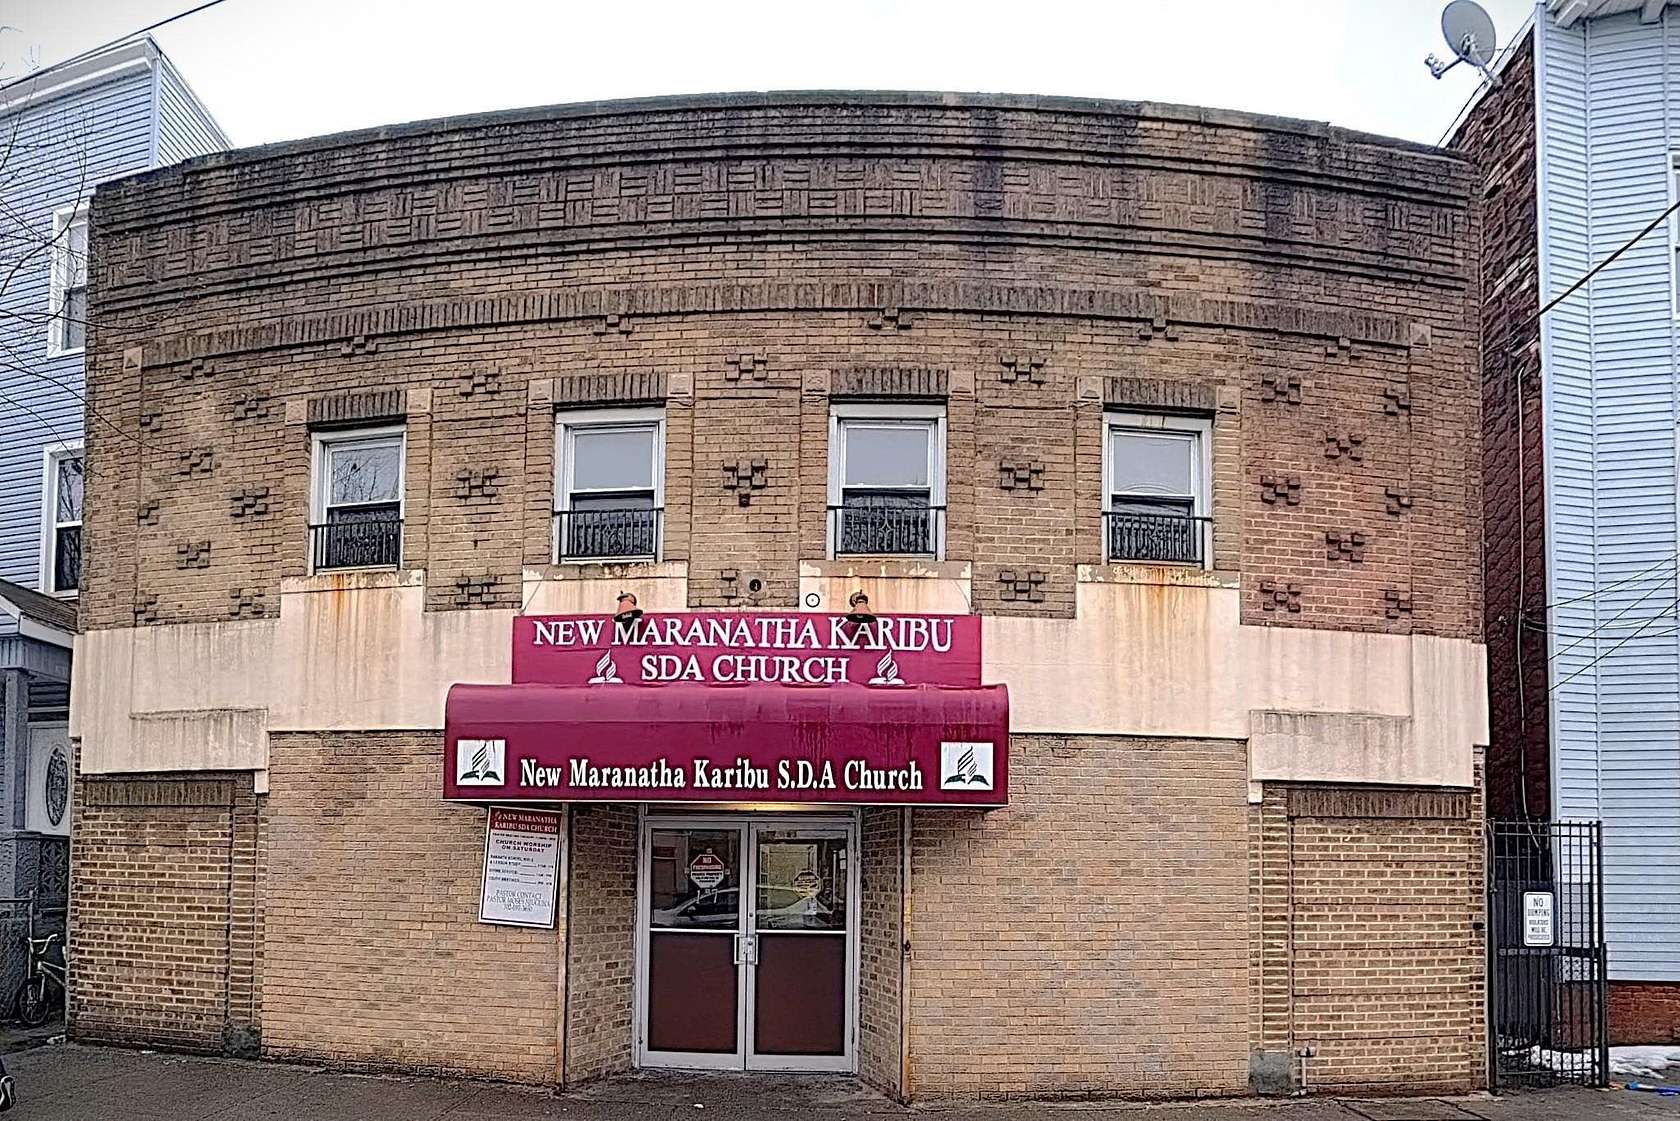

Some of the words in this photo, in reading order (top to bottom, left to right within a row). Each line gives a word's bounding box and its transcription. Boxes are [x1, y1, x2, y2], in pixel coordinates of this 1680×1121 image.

[533, 620, 605, 645] NEW
[611, 618, 821, 649] MARANATHA
[828, 617, 954, 652] KARIBU
[641, 654, 705, 681] SDA
[712, 655, 850, 683] CHURCH
[520, 758, 562, 787] New
[569, 758, 686, 788] Maranatha
[693, 758, 769, 789] Karibu
[777, 760, 836, 789] S.D.A
[844, 760, 923, 790] Church
[494, 821, 517, 830] KARIBU
[518, 823, 530, 831] SDA
[530, 824, 557, 833] CHURCH
[502, 813, 517, 821] NEW
[518, 814, 557, 824] MARANATHA
[1533, 897, 1544, 907] NO
